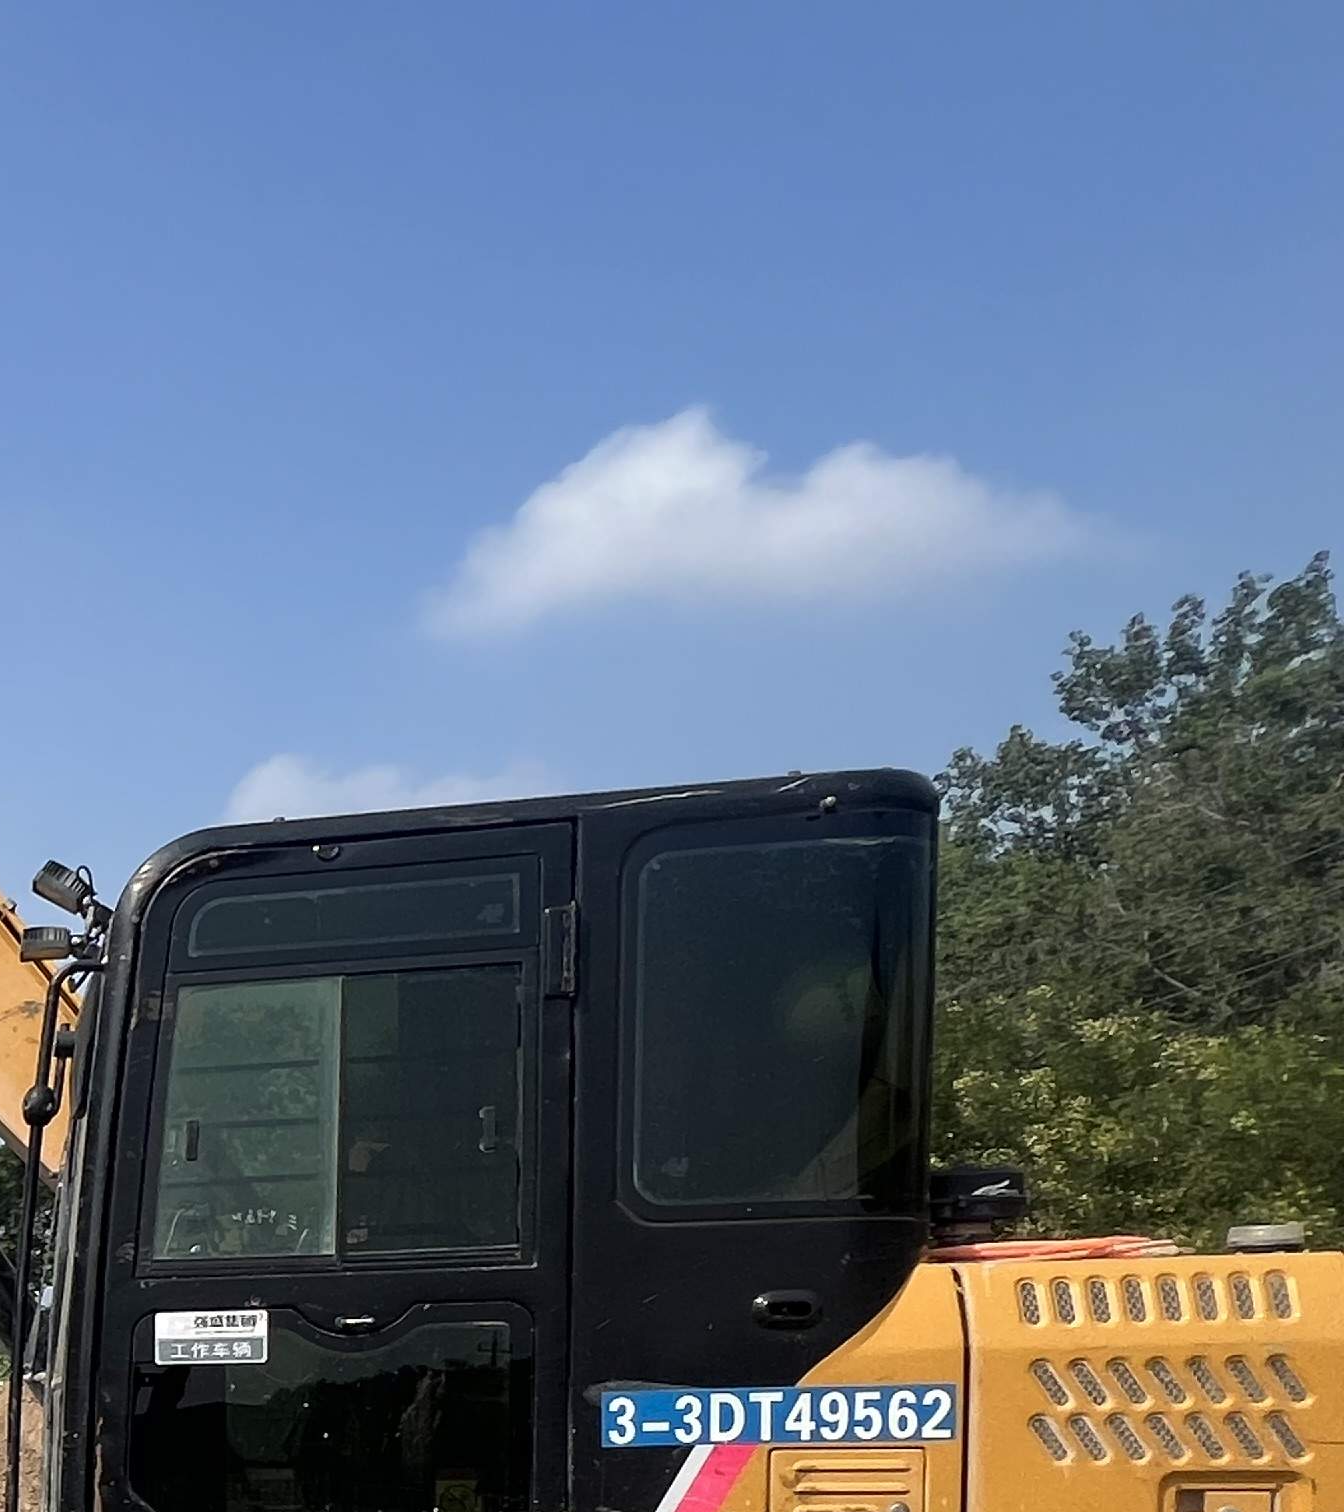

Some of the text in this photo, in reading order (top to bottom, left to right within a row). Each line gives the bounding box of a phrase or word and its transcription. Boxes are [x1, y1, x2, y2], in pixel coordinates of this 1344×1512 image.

[170, 1341, 252, 1359] 工作车辆
[607, 1388, 954, 1446] 3-3DT49562
